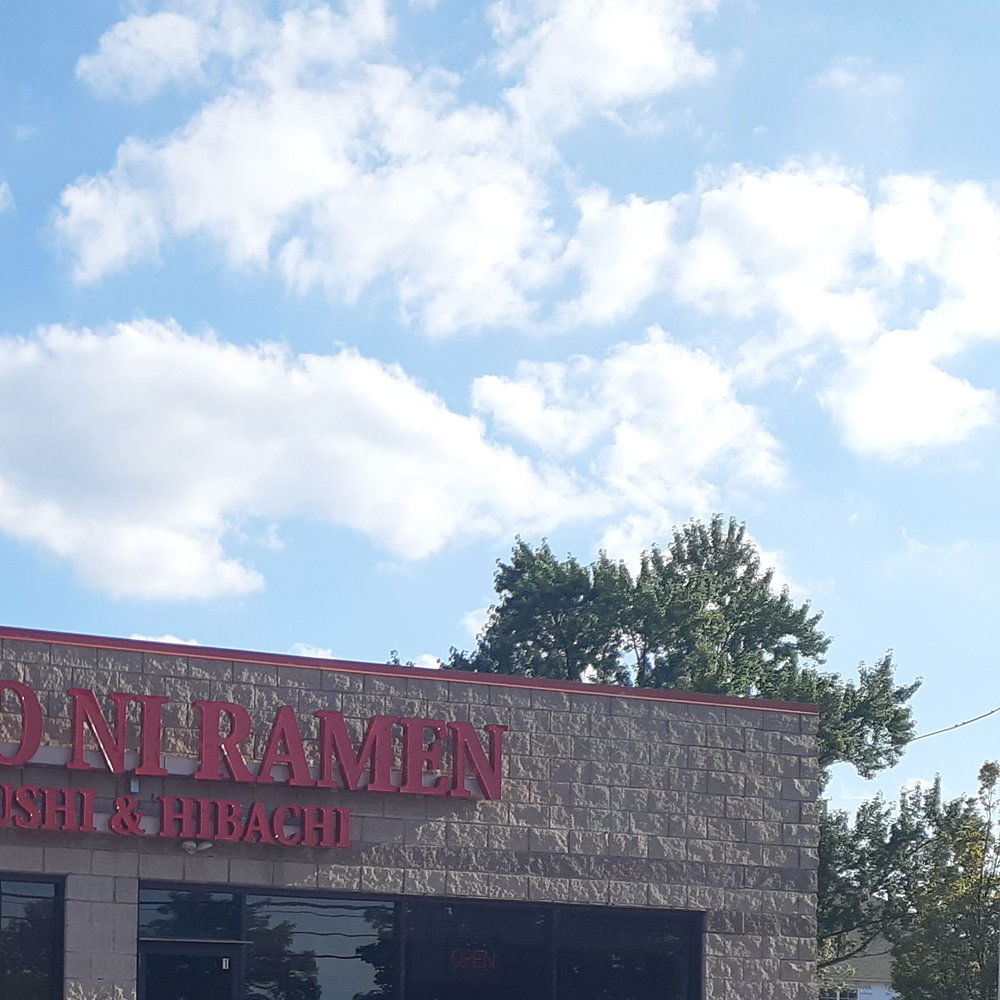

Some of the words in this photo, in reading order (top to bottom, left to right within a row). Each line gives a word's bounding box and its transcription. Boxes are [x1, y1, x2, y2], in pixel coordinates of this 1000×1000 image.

[66, 688, 169, 776] NI
[192, 700, 508, 800] RAMEN
[108, 795, 146, 835] &
[159, 796, 354, 848] HIBACHI
[450, 949, 496, 970] OPEN
